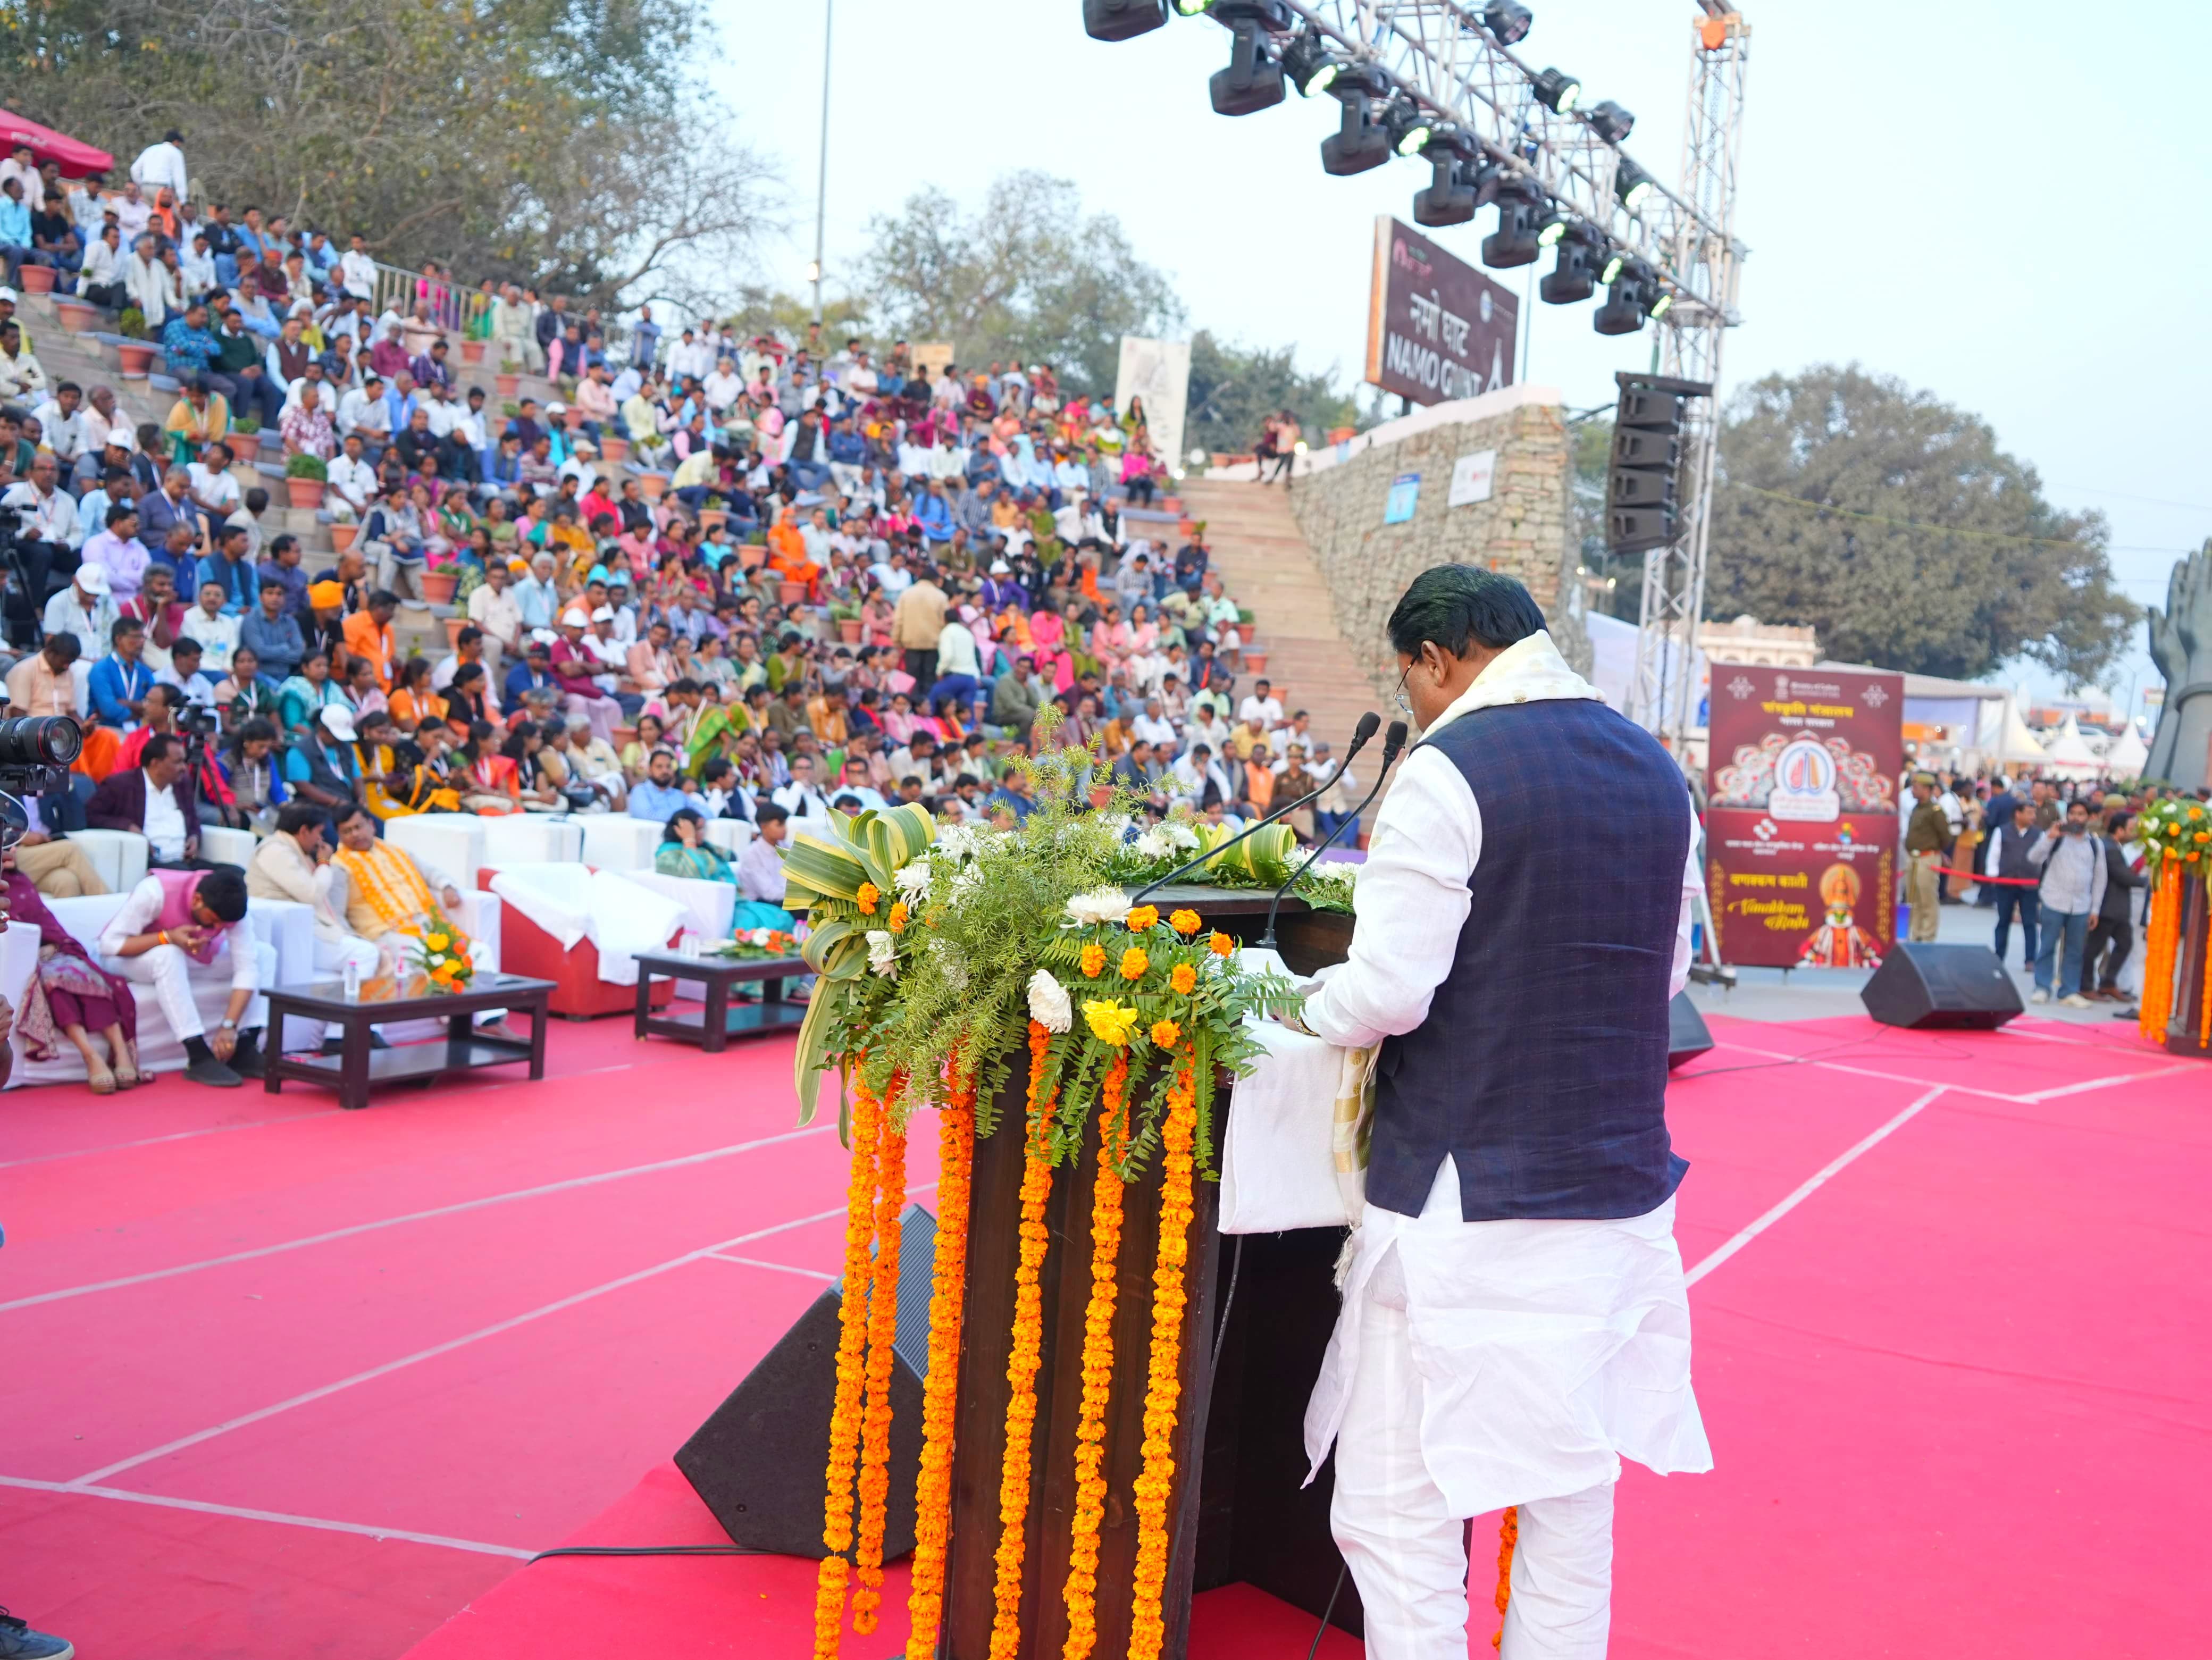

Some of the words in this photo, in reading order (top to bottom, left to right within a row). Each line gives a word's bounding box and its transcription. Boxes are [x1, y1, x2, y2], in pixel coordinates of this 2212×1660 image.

[1410, 288, 1442, 343] नमो
[1442, 309, 1471, 357] घाट
[1386, 330, 1440, 390] NAMO
